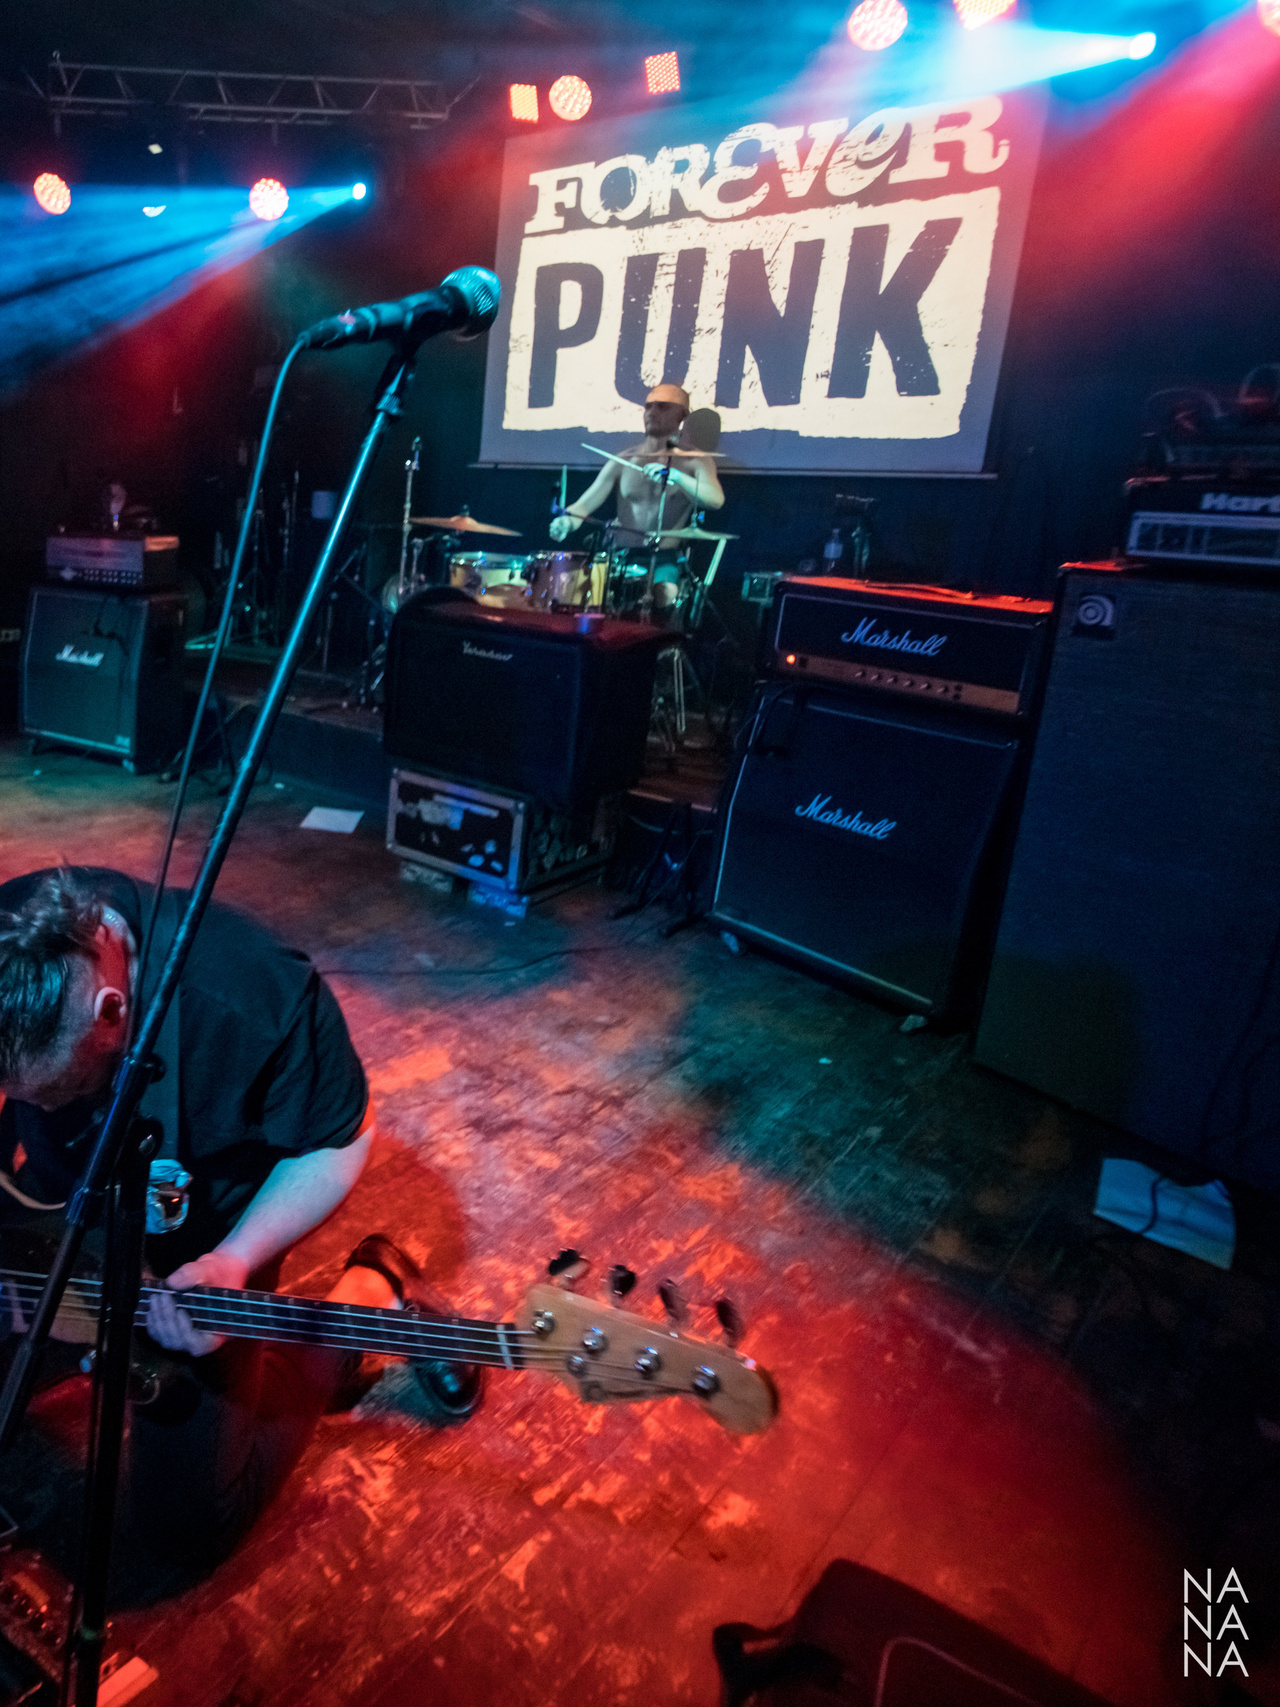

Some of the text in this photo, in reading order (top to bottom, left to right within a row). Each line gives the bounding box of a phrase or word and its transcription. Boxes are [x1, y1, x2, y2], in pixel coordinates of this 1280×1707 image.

[527, 217, 964, 410] PUNK
[841, 617, 948, 657] Marshall
[795, 793, 897, 840] Marshall
